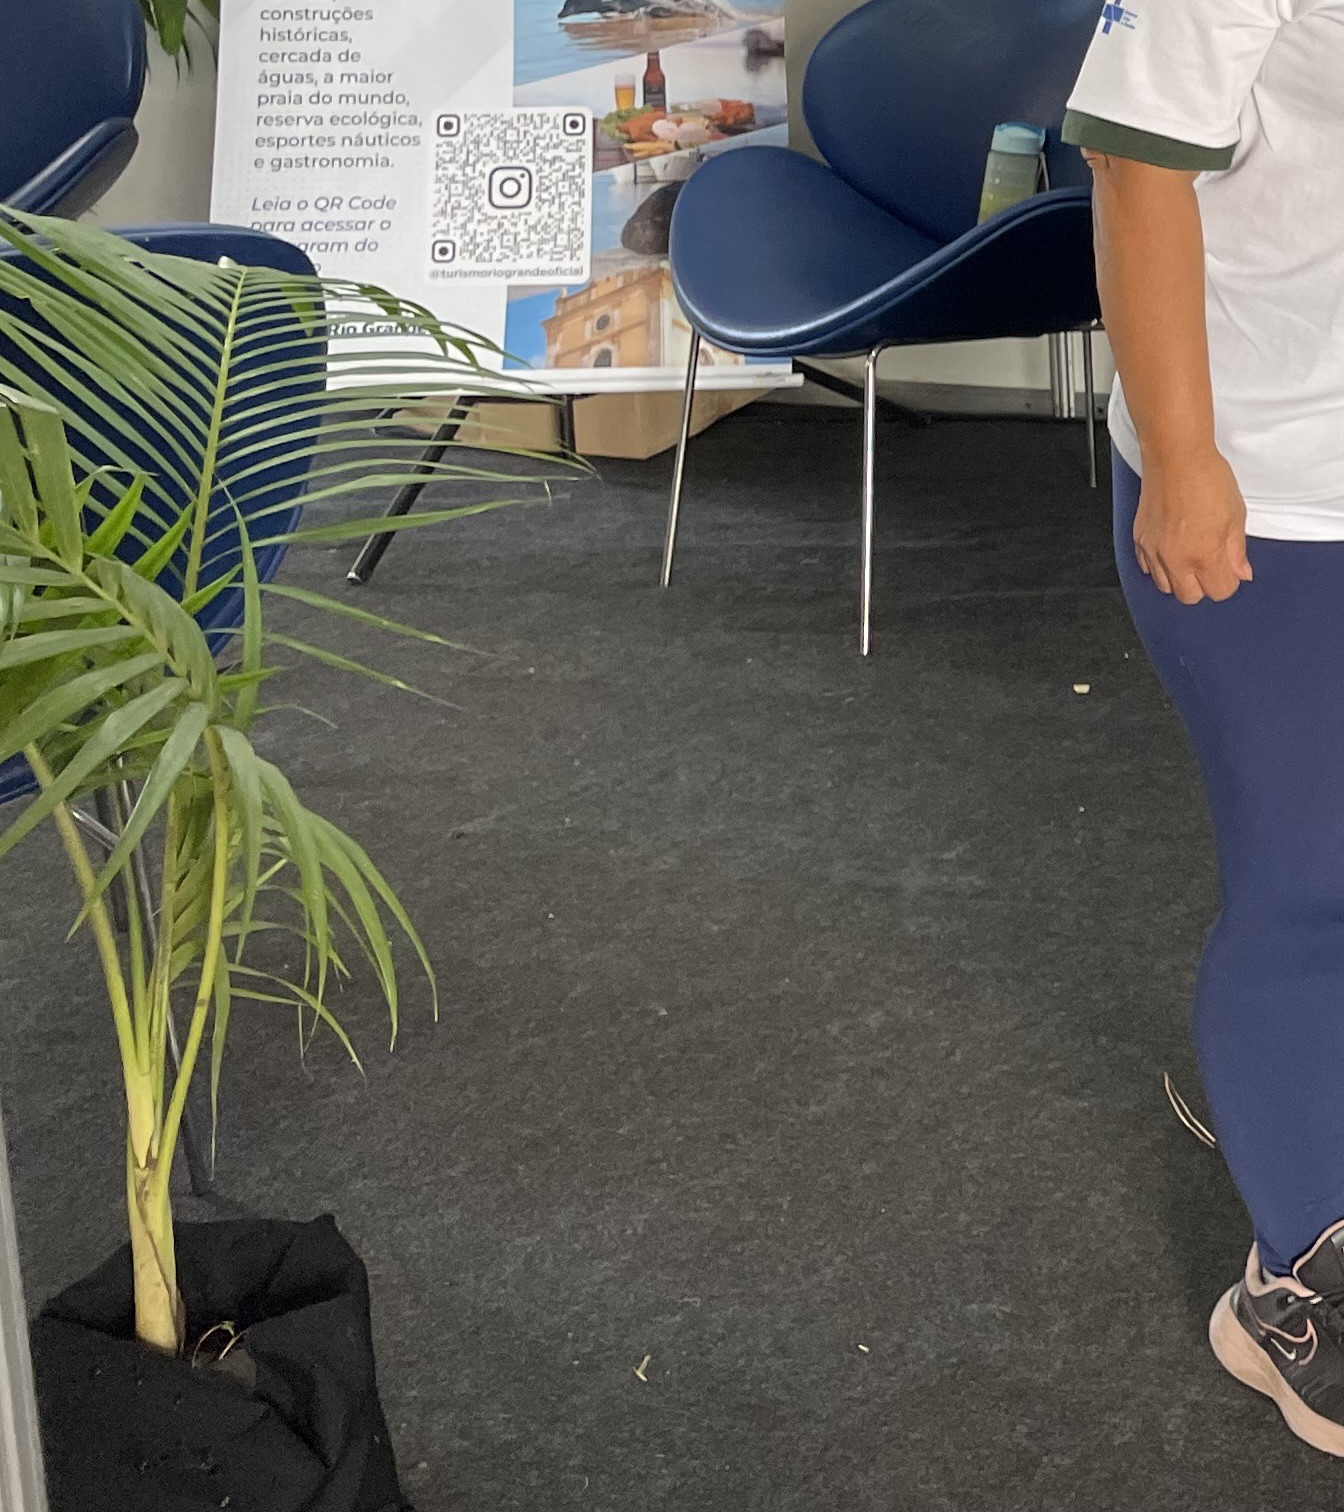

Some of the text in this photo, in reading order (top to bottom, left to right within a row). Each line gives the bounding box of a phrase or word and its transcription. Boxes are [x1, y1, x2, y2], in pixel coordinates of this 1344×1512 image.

[260, 6, 374, 25] construções
[260, 26, 353, 44] históricas,
[258, 48, 361, 63] cercada de
[258, 68, 394, 88] águas, a maior
[257, 90, 410, 109] praia do mundo,
[256, 110, 423, 129] reserva ecológica,
[255, 132, 421, 150] esportes náuticos
[254, 153, 395, 172] e gastronomia.
[251, 195, 397, 213] Leia o QR Code
[251, 219, 392, 232] para acessar o
[354, 238, 379, 253] do
